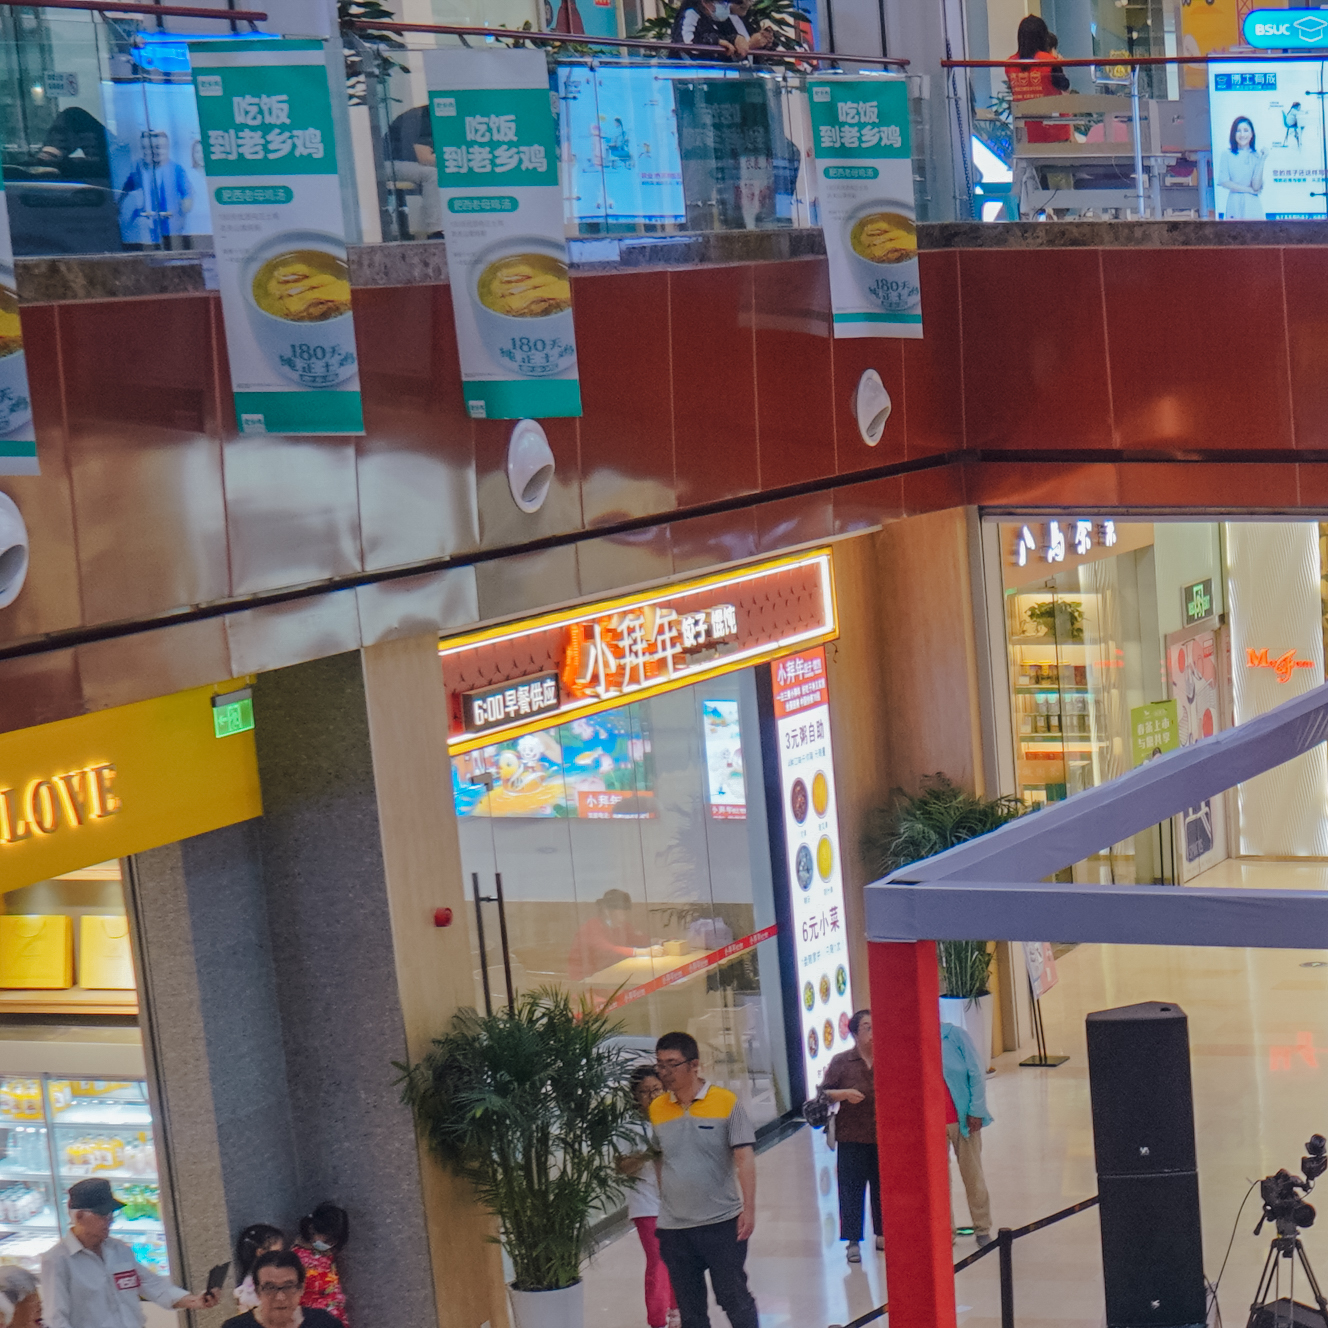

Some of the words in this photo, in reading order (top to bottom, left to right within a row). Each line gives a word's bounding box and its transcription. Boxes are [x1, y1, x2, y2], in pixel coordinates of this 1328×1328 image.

[1255, 24, 1291, 36] BSUC
[232, 94, 291, 126] 吃饭
[837, 101, 879, 124] 吃饭
[465, 115, 518, 142] 吃饭
[819, 125, 902, 148] 到老乡鸡
[207, 127, 324, 161] 到老乡鸡
[443, 144, 547, 174] 到老乡鸡
[875, 278, 911, 292] 180天
[289, 343, 342, 361] 180天
[509, 336, 562, 353] 180天
[580, 606, 683, 700] 小拜年
[681, 612, 708, 648] 饺子
[711, 604, 737, 640] 馄饨
[473, 678, 558, 727] 6:00早餐供应
[785, 719, 825, 750] 3元粥自助
[0, 761, 122, 844] LOVE
[802, 905, 840, 942] 6元小菜
